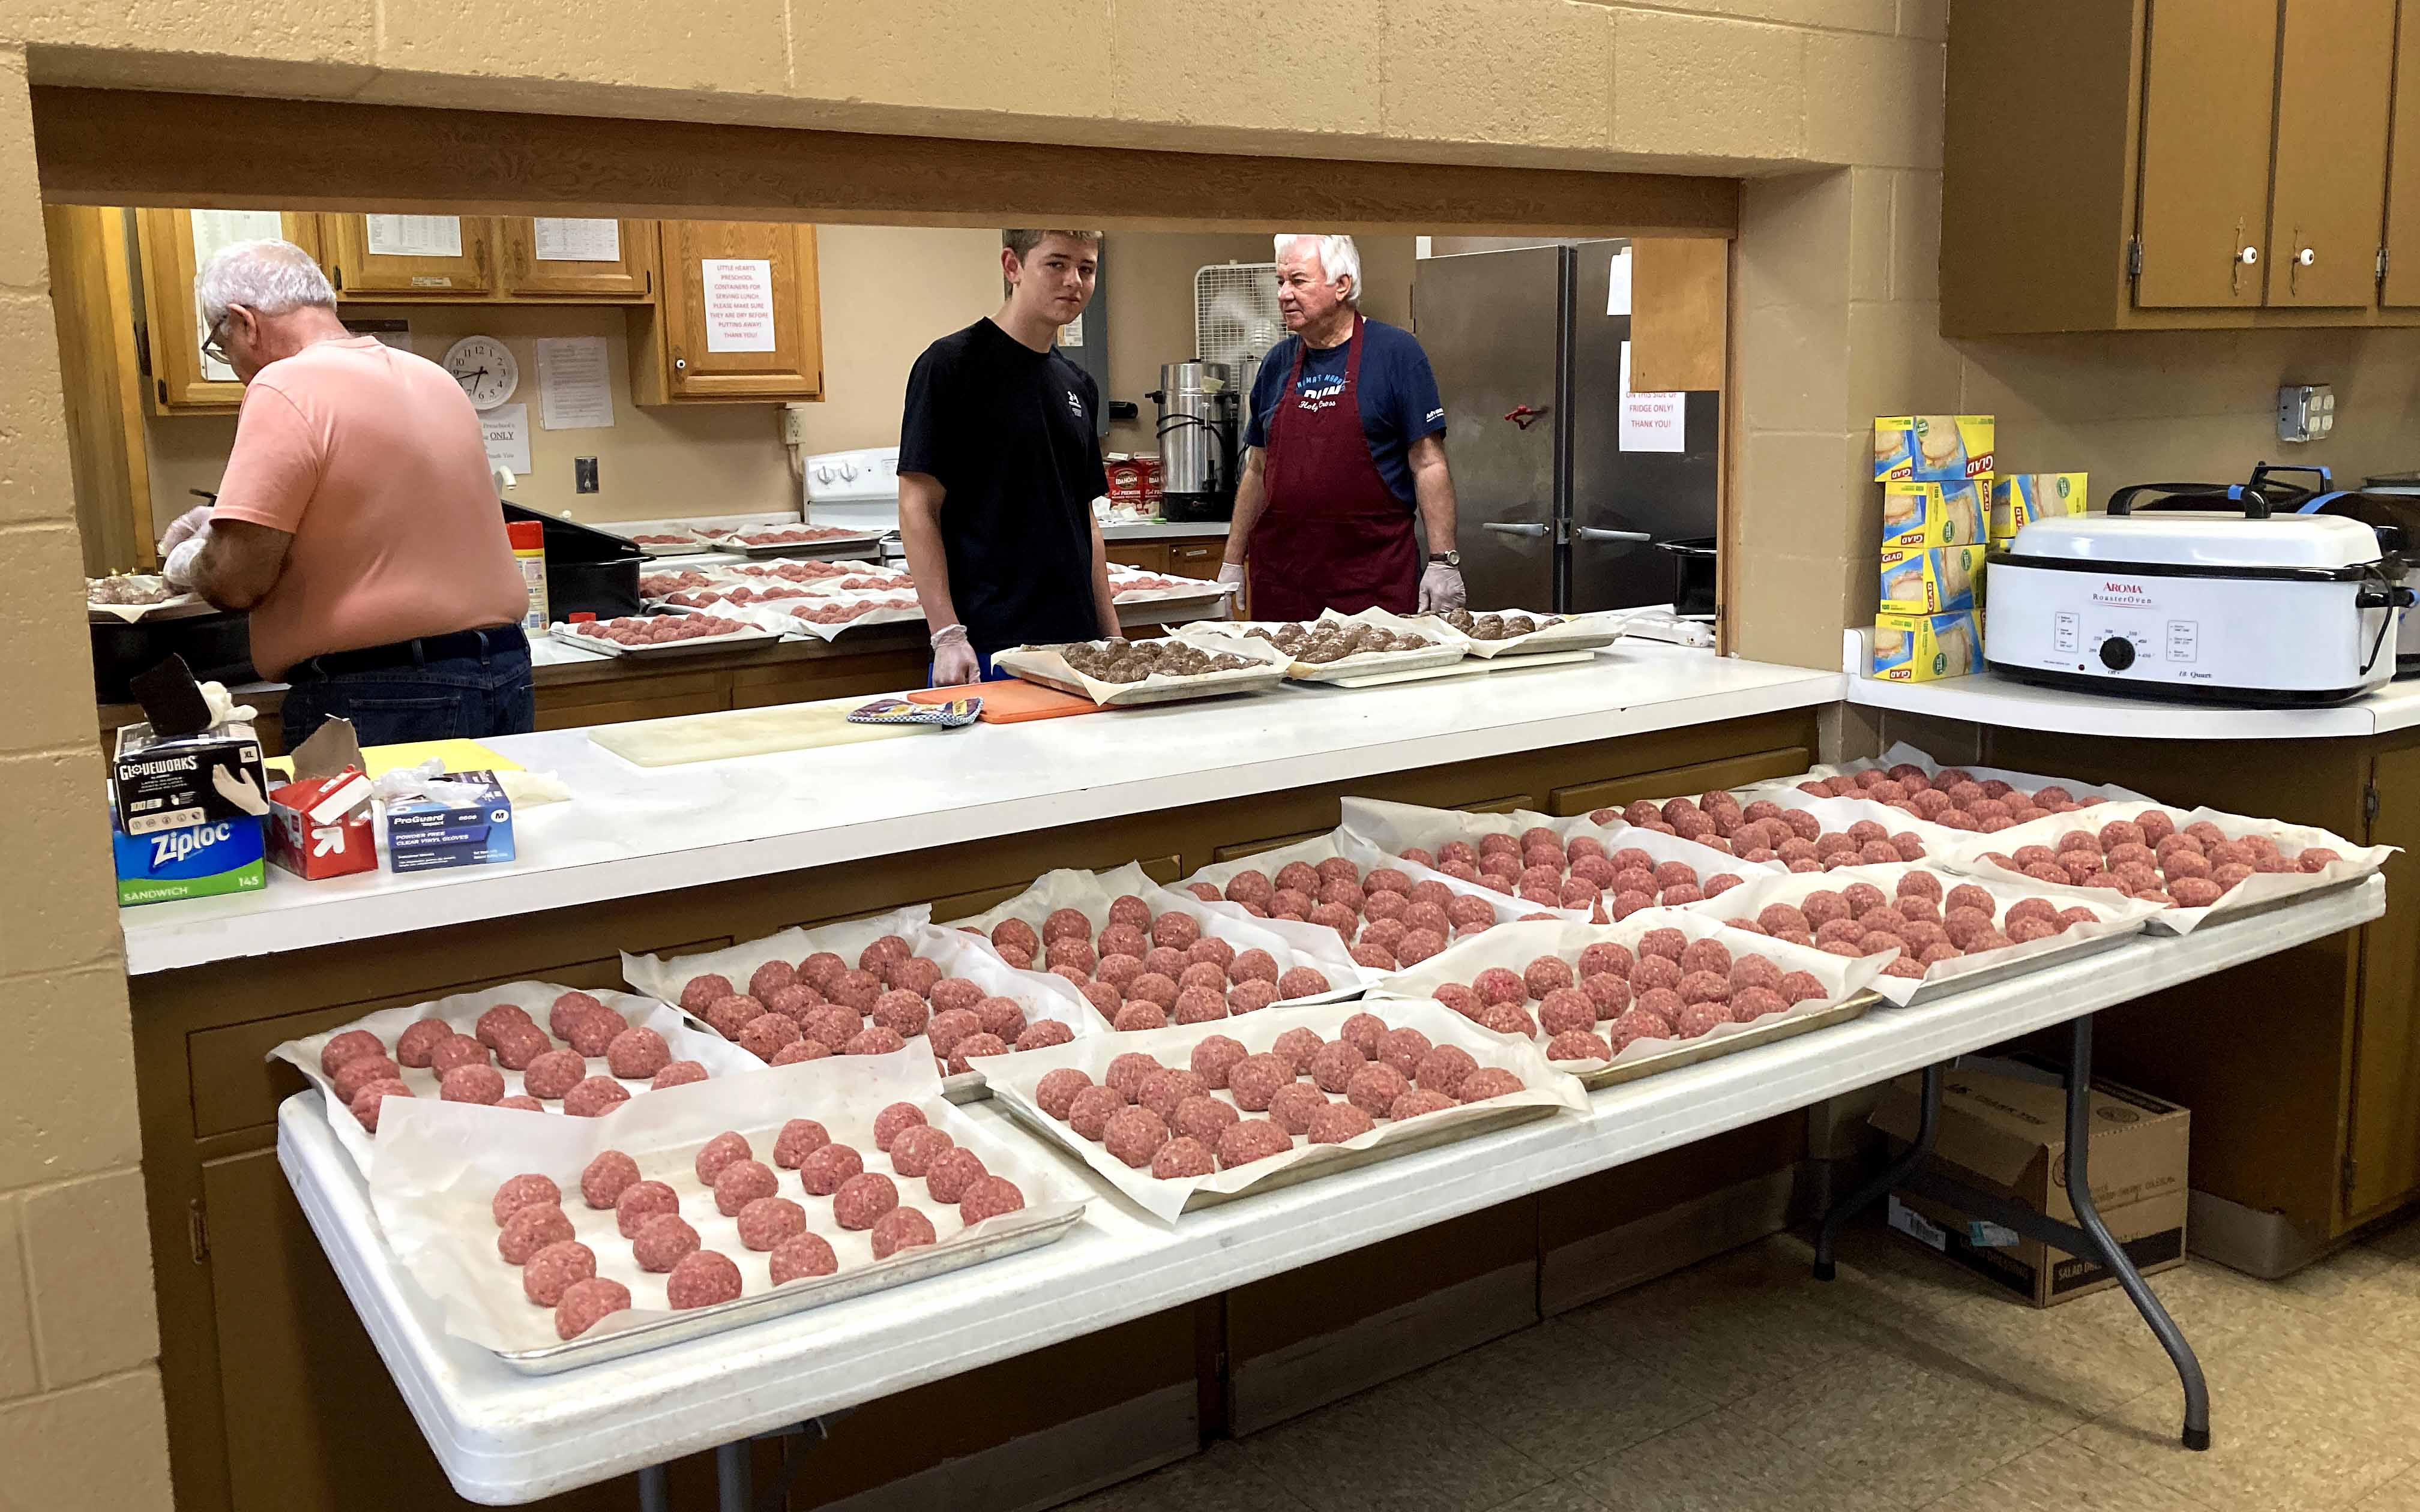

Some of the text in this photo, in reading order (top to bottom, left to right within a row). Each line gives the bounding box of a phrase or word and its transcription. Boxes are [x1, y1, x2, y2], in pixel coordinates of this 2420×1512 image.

[464, 349, 471, 358] 11
[475, 346, 484, 355] 12
[497, 357, 503, 365] 2
[501, 368, 506, 377] 3
[478, 391, 484, 400] 6
[1298, 401, 1319, 412] Holy
[1629, 404, 1674, 413] FRIDGE ONLY!
[490, 431, 514, 440] ONLY
[1967, 455, 1993, 474] GLAD
[1892, 468, 1911, 478] GLAD
[1115, 476, 1137, 485] IDAHOAN
[1901, 535, 1923, 543] GLAD
[1882, 552, 1903, 562] GLAD
[2103, 581, 2143, 593] AROMA
[1891, 670, 1910, 679] GLAD
[119, 755, 199, 781] GLOVEWORKS
[394, 814, 445, 825] ProGuard
[151, 823, 230, 866] Ziploc
[239, 875, 259, 887] 145
[124, 886, 188, 902] SANDWICH
